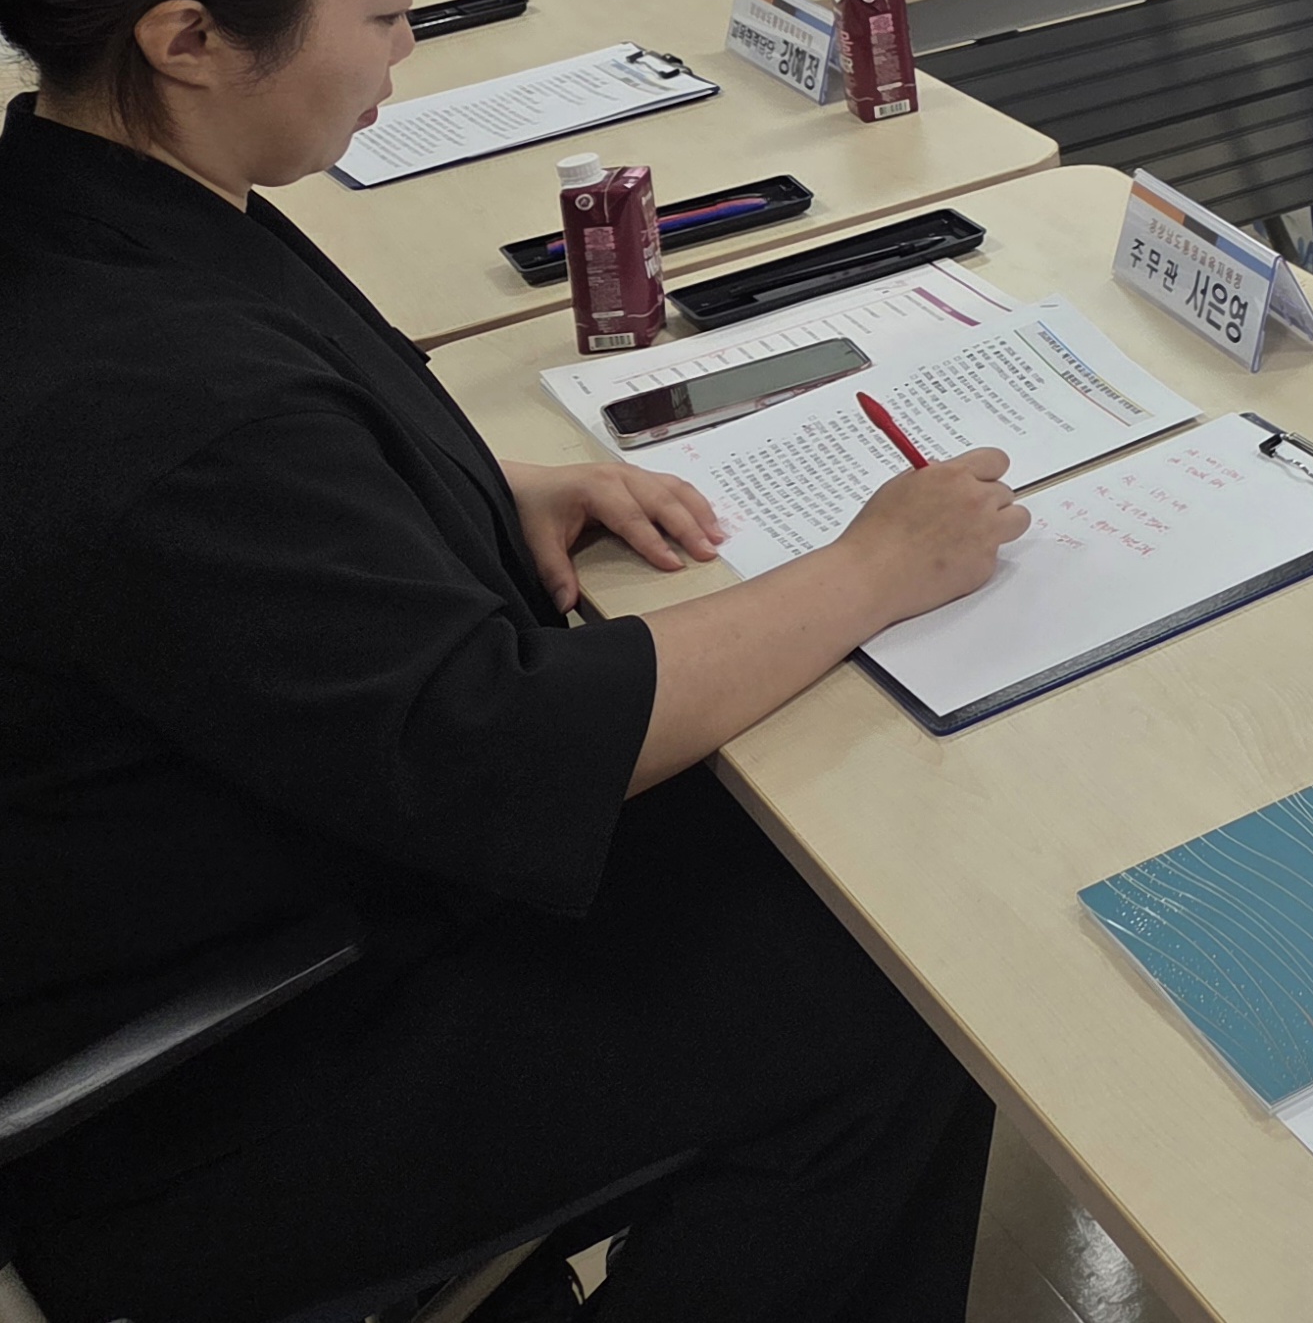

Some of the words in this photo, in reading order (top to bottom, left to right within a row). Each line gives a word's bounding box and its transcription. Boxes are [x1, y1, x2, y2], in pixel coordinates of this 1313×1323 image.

[1130, 238, 1180, 293] 주무관
[1185, 270, 1249, 344] 서은영
[1149, 218, 1244, 290] 경상남도통영교육지원청
